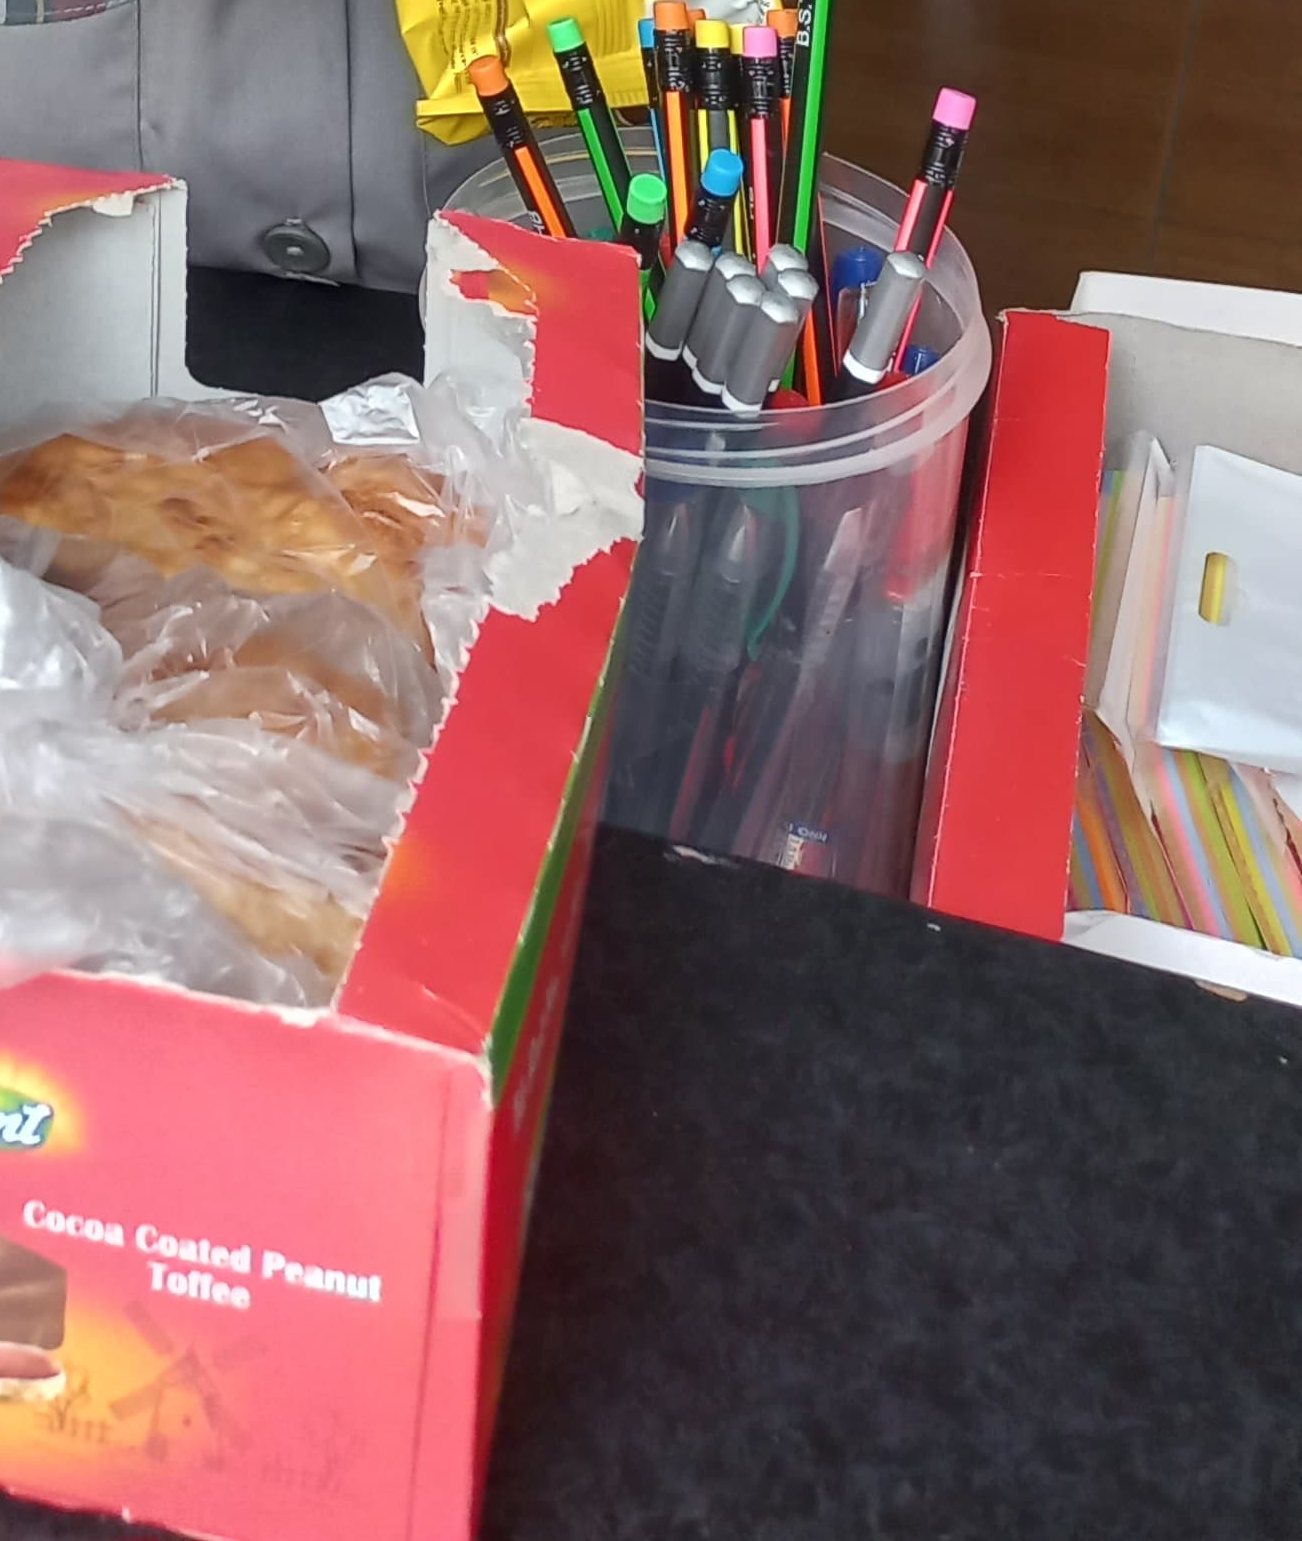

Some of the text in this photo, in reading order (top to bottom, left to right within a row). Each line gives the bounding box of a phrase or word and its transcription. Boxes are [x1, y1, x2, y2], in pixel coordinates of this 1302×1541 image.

[22, 1199, 383, 1304] Cocoa Coated Peanut
[147, 1260, 251, 1310] Toffee
